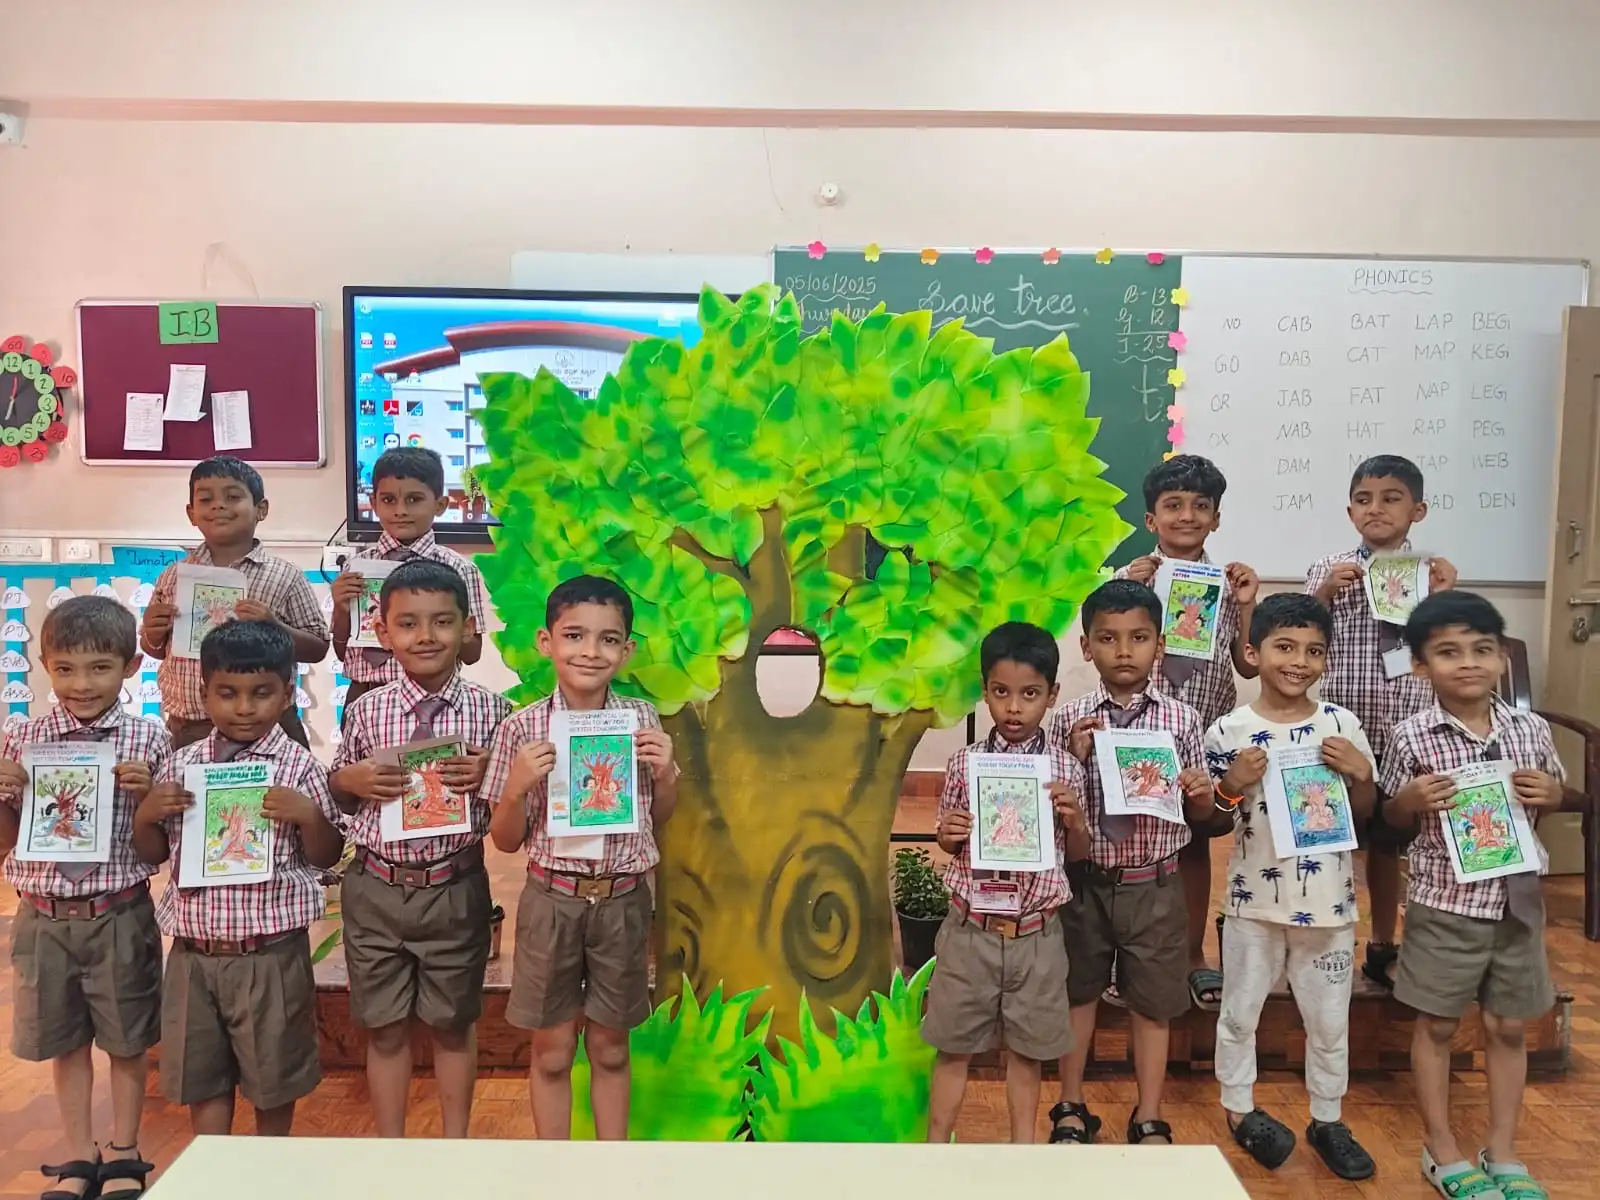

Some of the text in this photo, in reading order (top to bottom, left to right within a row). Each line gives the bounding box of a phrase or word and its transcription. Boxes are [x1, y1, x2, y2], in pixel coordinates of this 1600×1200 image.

[785, 272, 876, 295] 05/06/2025
[1354, 267, 1433, 286] PHONICS
[918, 279, 995, 315] Save
[1222, 311, 1511, 332] NO CAB BAT LAP BEG
[8, 341, 22, 350] 60
[7, 356, 18, 367] 12
[1214, 341, 1510, 373] GO DAB CAT MAP KEG
[28, 363, 34, 374] 1
[40, 378, 47, 389] 2
[61, 373, 73, 383] 10
[1210, 381, 1507, 412] OR JAB FAT NAP LEG
[42, 398, 52, 411] 3
[36, 416, 45, 427] 4
[6, 432, 15, 443] 6
[25, 427, 33, 439] 5
[1208, 418, 1505, 448] OX NAB HAT RAP PEG
[1277, 458, 1310, 475] DAM
[1272, 493, 1313, 511] JAM
[1479, 491, 1515, 509] DEN
